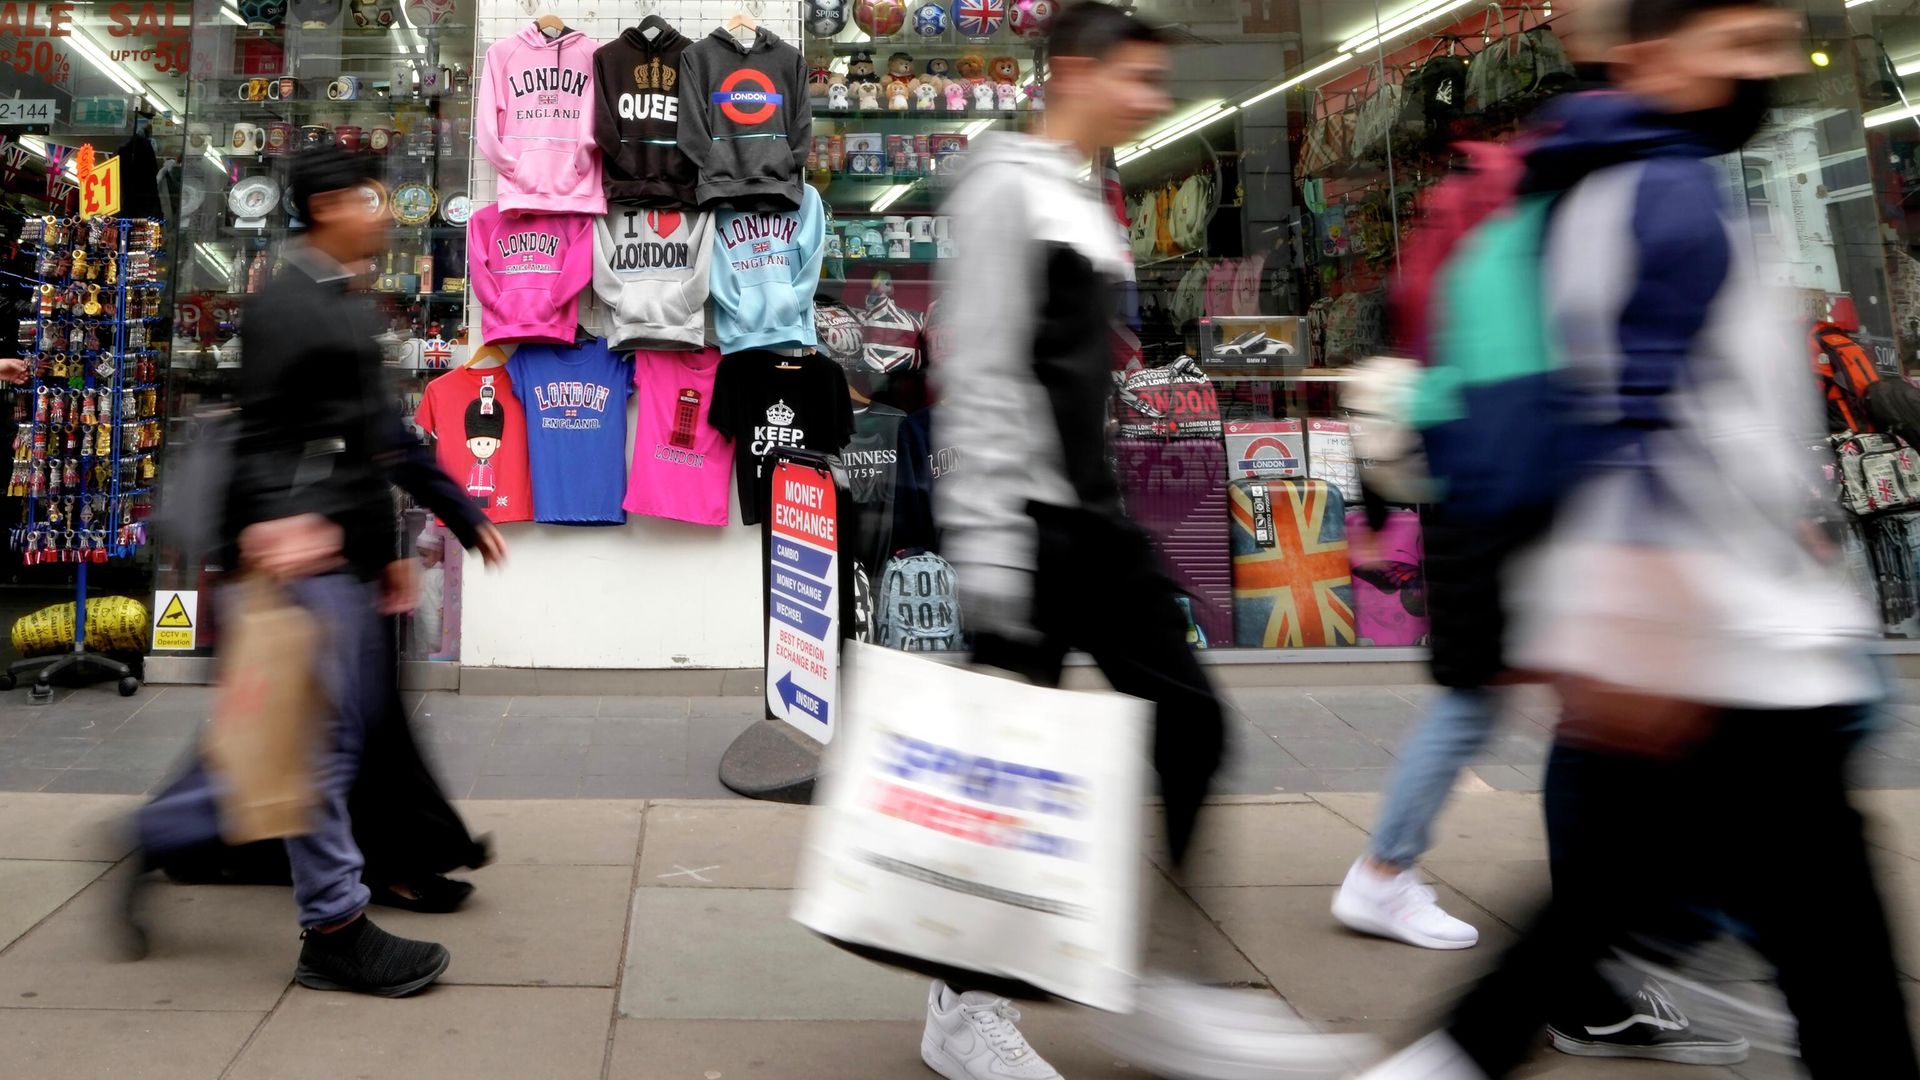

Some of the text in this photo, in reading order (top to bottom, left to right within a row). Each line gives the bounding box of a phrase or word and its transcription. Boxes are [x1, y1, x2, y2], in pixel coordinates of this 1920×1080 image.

[816, 9, 840, 18] SPURS
[509, 67, 589, 98] LONDON
[618, 93, 678, 122] QUEE
[730, 93, 767, 101] LONDON
[516, 109, 580, 119] ENGLAND
[84, 168, 111, 215] £1
[624, 211, 638, 238] I
[720, 214, 798, 249] LONDON
[497, 232, 559, 258] LONDON
[616, 242, 688, 270] LONDON
[732, 255, 791, 271] ENGLAND
[535, 382, 609, 412] LONDON
[542, 417, 599, 429] ENGLAND
[754, 426, 804, 443] KEEP
[655, 443, 705, 468] LONDON
[1252, 459, 1285, 468] LONDON
[785, 480, 824, 510] MONEY
[776, 503, 834, 541] EXCHANGE
[777, 544, 799, 562] CAMBIO
[776, 573, 822, 600] MONEY CHANGE
[898, 570, 950, 597] LON
[775, 602, 803, 625] WECHSEL
[898, 602, 953, 630] DON
[779, 630, 824, 661] BEST FOREIGN
[776, 643, 827, 680] EXCHANGE RATE
[795, 690, 819, 715] INSIDE
